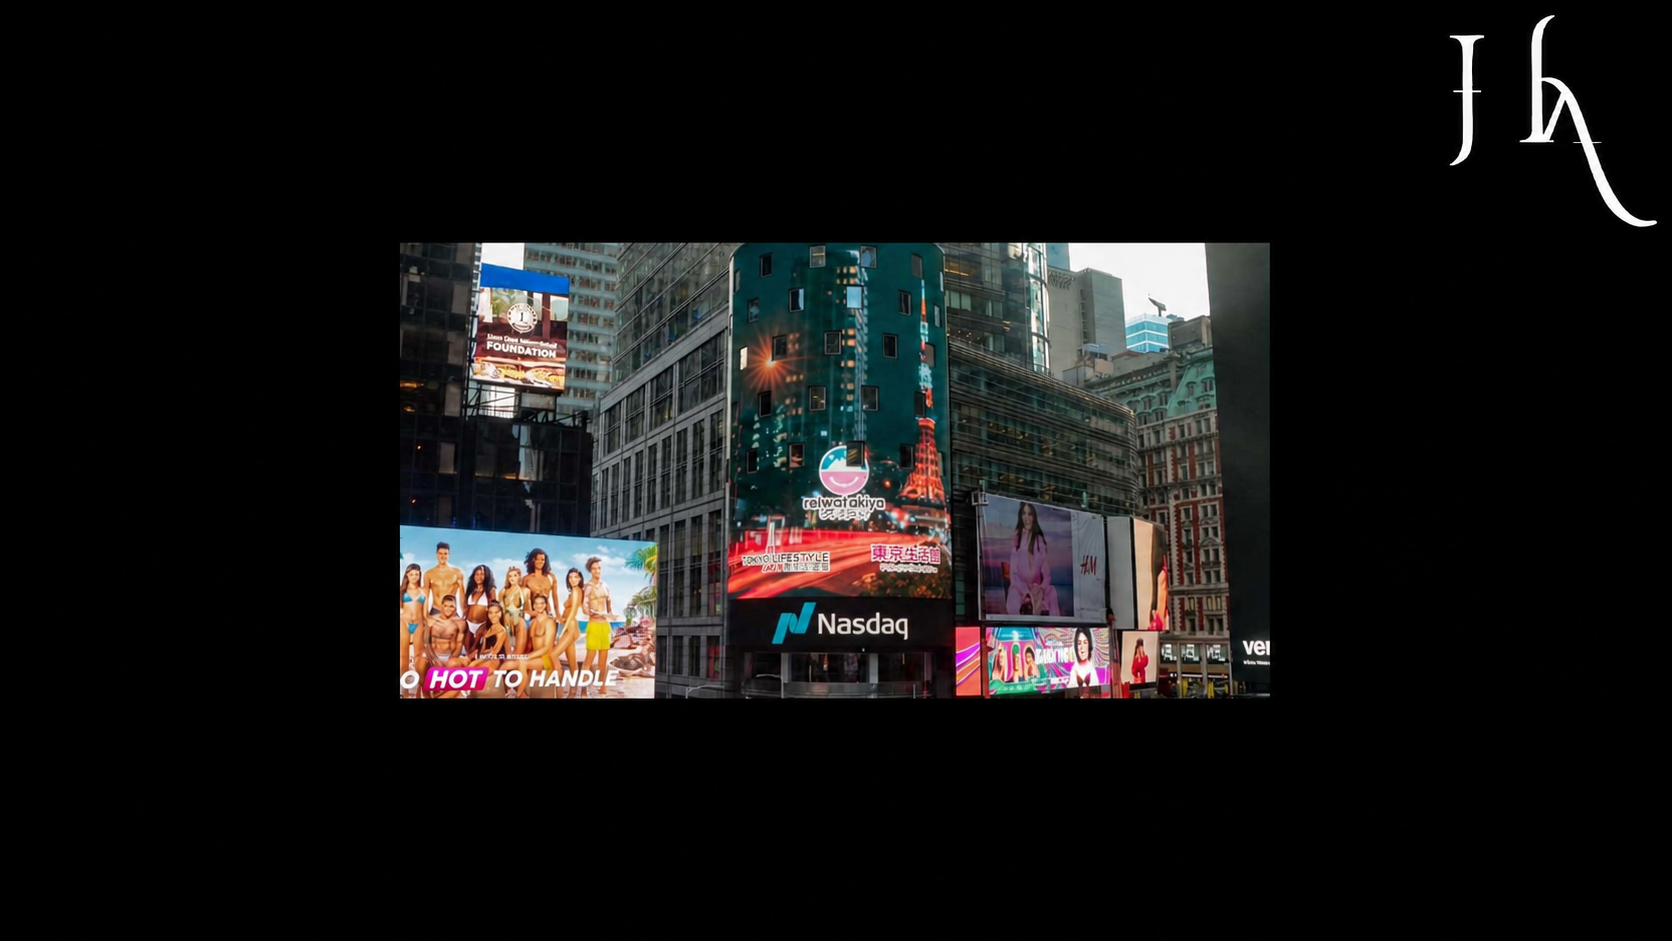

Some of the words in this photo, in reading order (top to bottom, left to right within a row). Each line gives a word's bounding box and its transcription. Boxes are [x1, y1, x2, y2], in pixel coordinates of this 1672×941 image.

[818, 612, 909, 641] Nasdaq
[430, 670, 484, 689] HOT
[494, 669, 523, 688] TO
[530, 669, 619, 688] HANDLE
